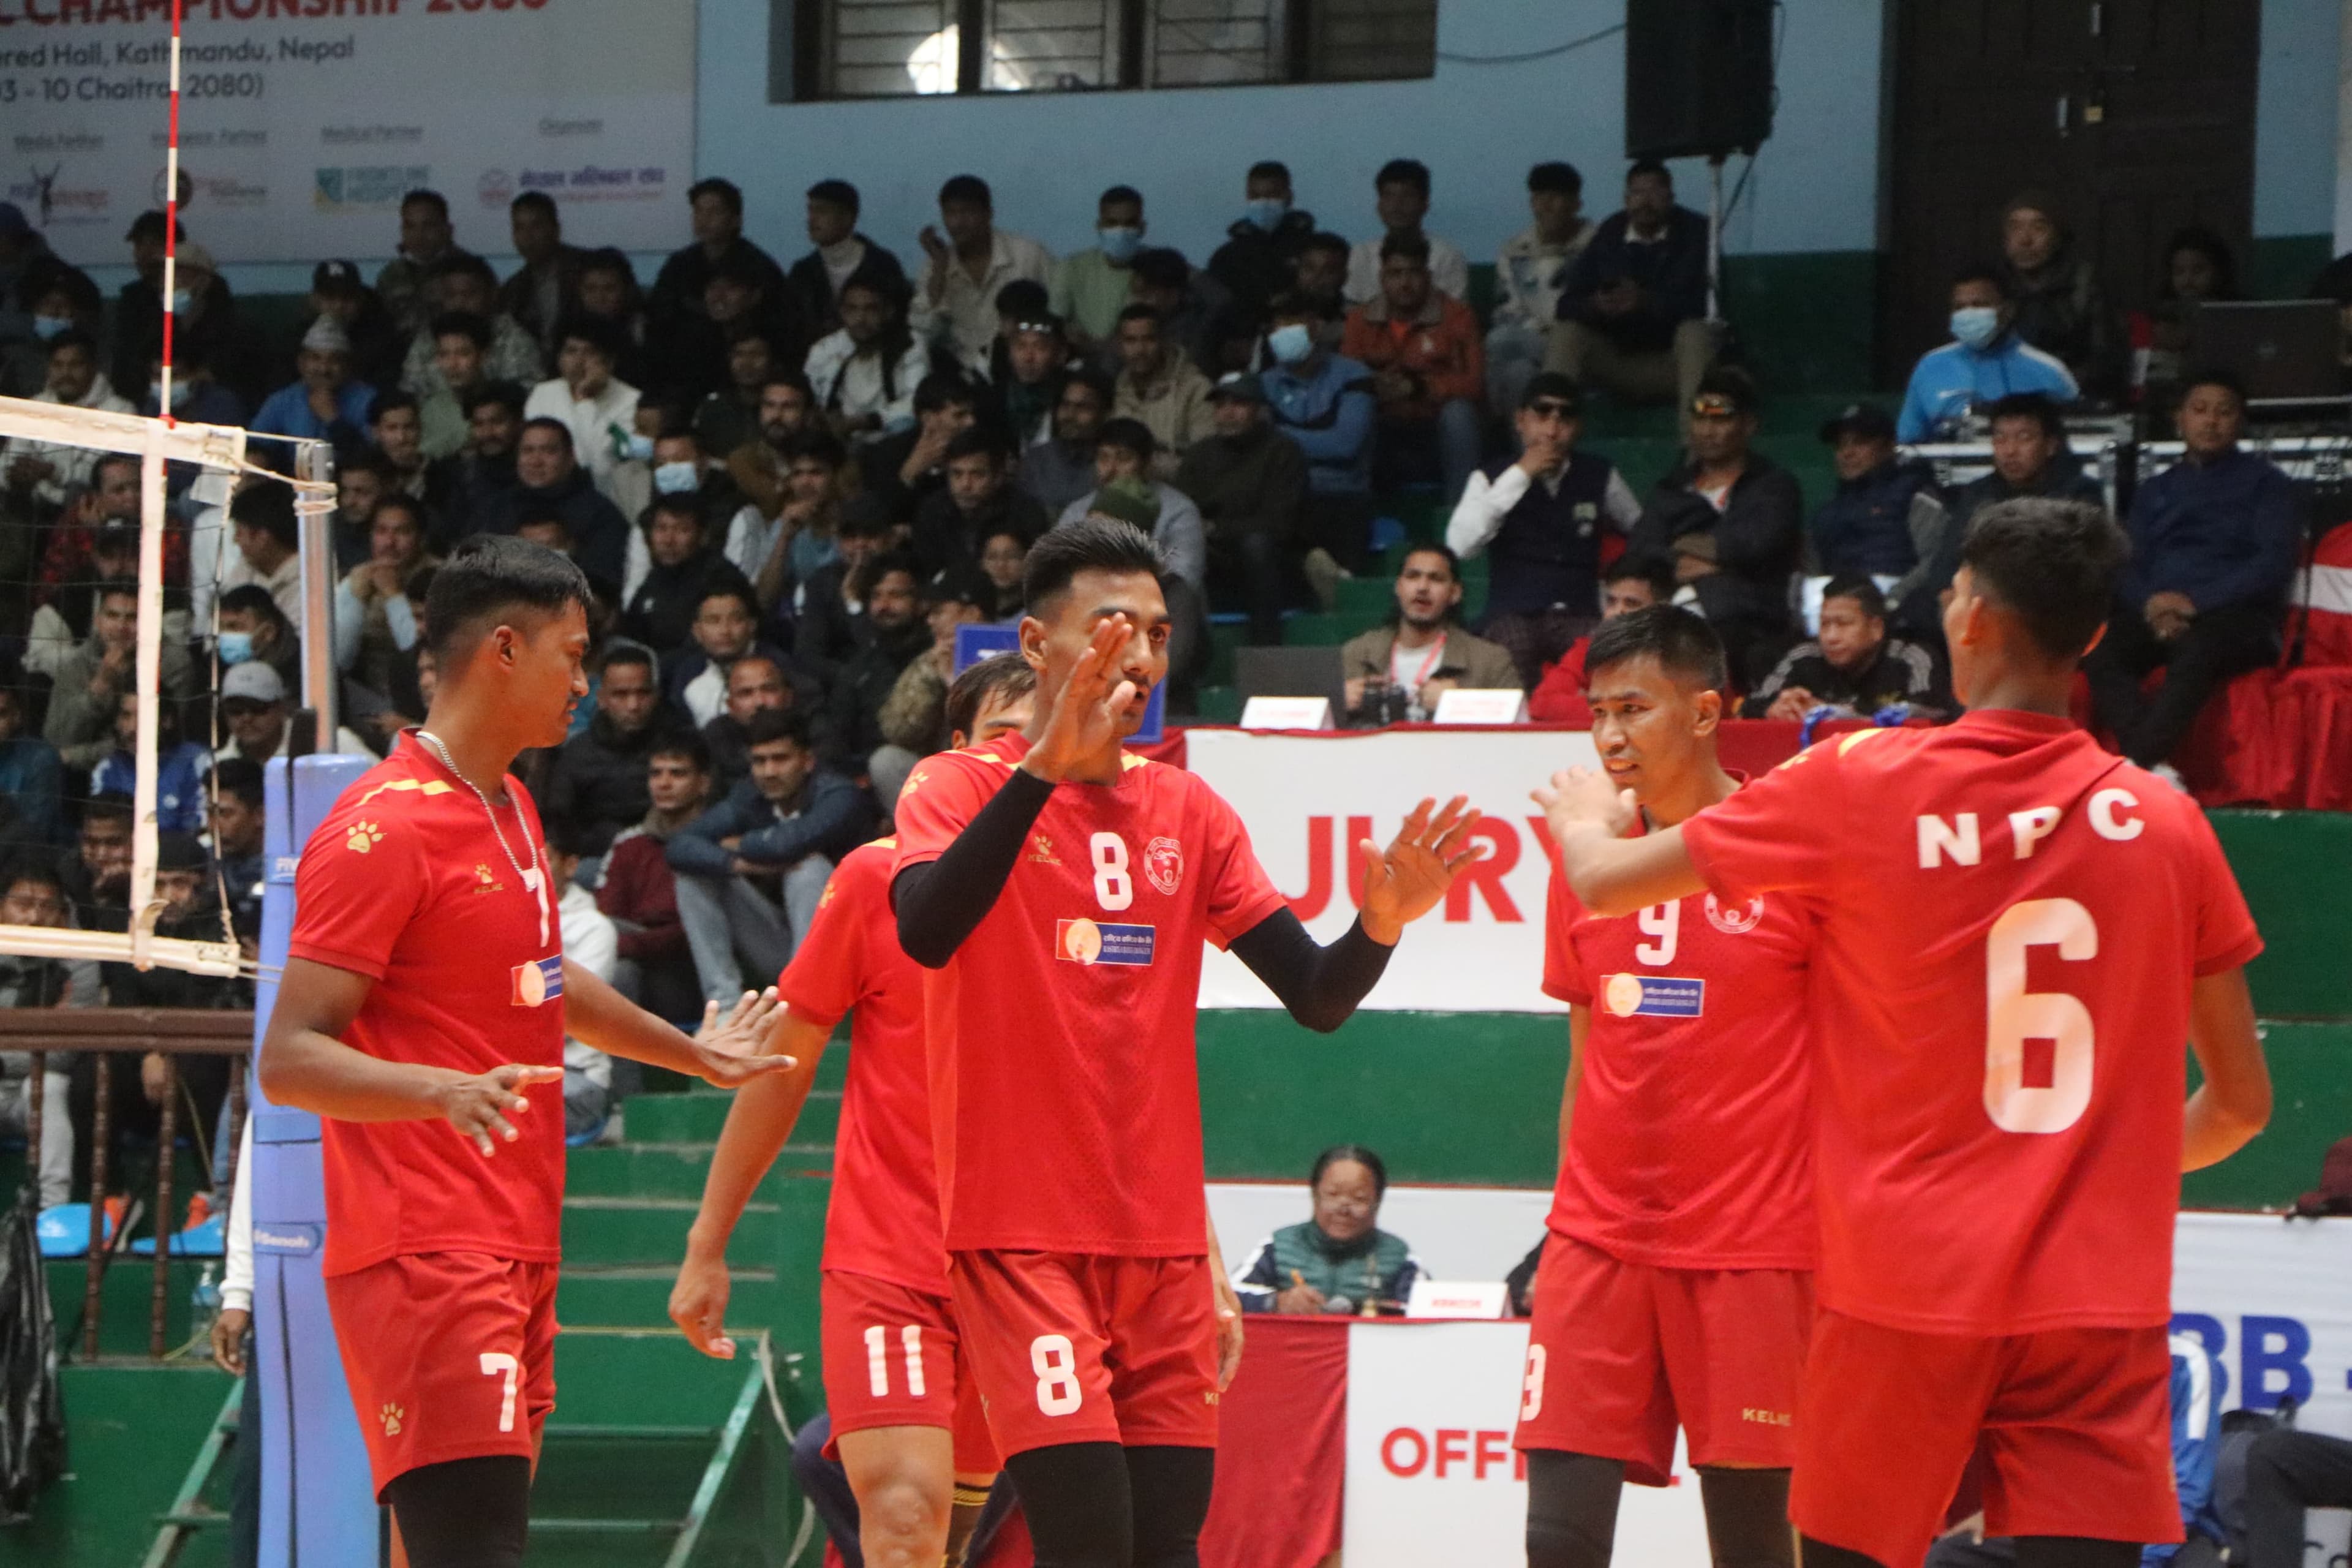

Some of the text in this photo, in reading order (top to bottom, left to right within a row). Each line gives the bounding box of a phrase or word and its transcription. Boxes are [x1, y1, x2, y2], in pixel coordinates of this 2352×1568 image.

[42, 77, 70, 102] 10
[186, 72, 265, 100] 2080)
[52, 42, 107, 67] Hall,
[278, 35, 355, 64] Nepal
[1090, 832, 1133, 911] 8
[1281, 816, 1558, 923] JUR
[1635, 898, 1681, 966] 9
[1983, 897, 2098, 1134] 6
[479, 1352, 518, 1433] 7
[864, 1324, 926, 1397] 11
[1030, 1333, 1083, 1417] 8
